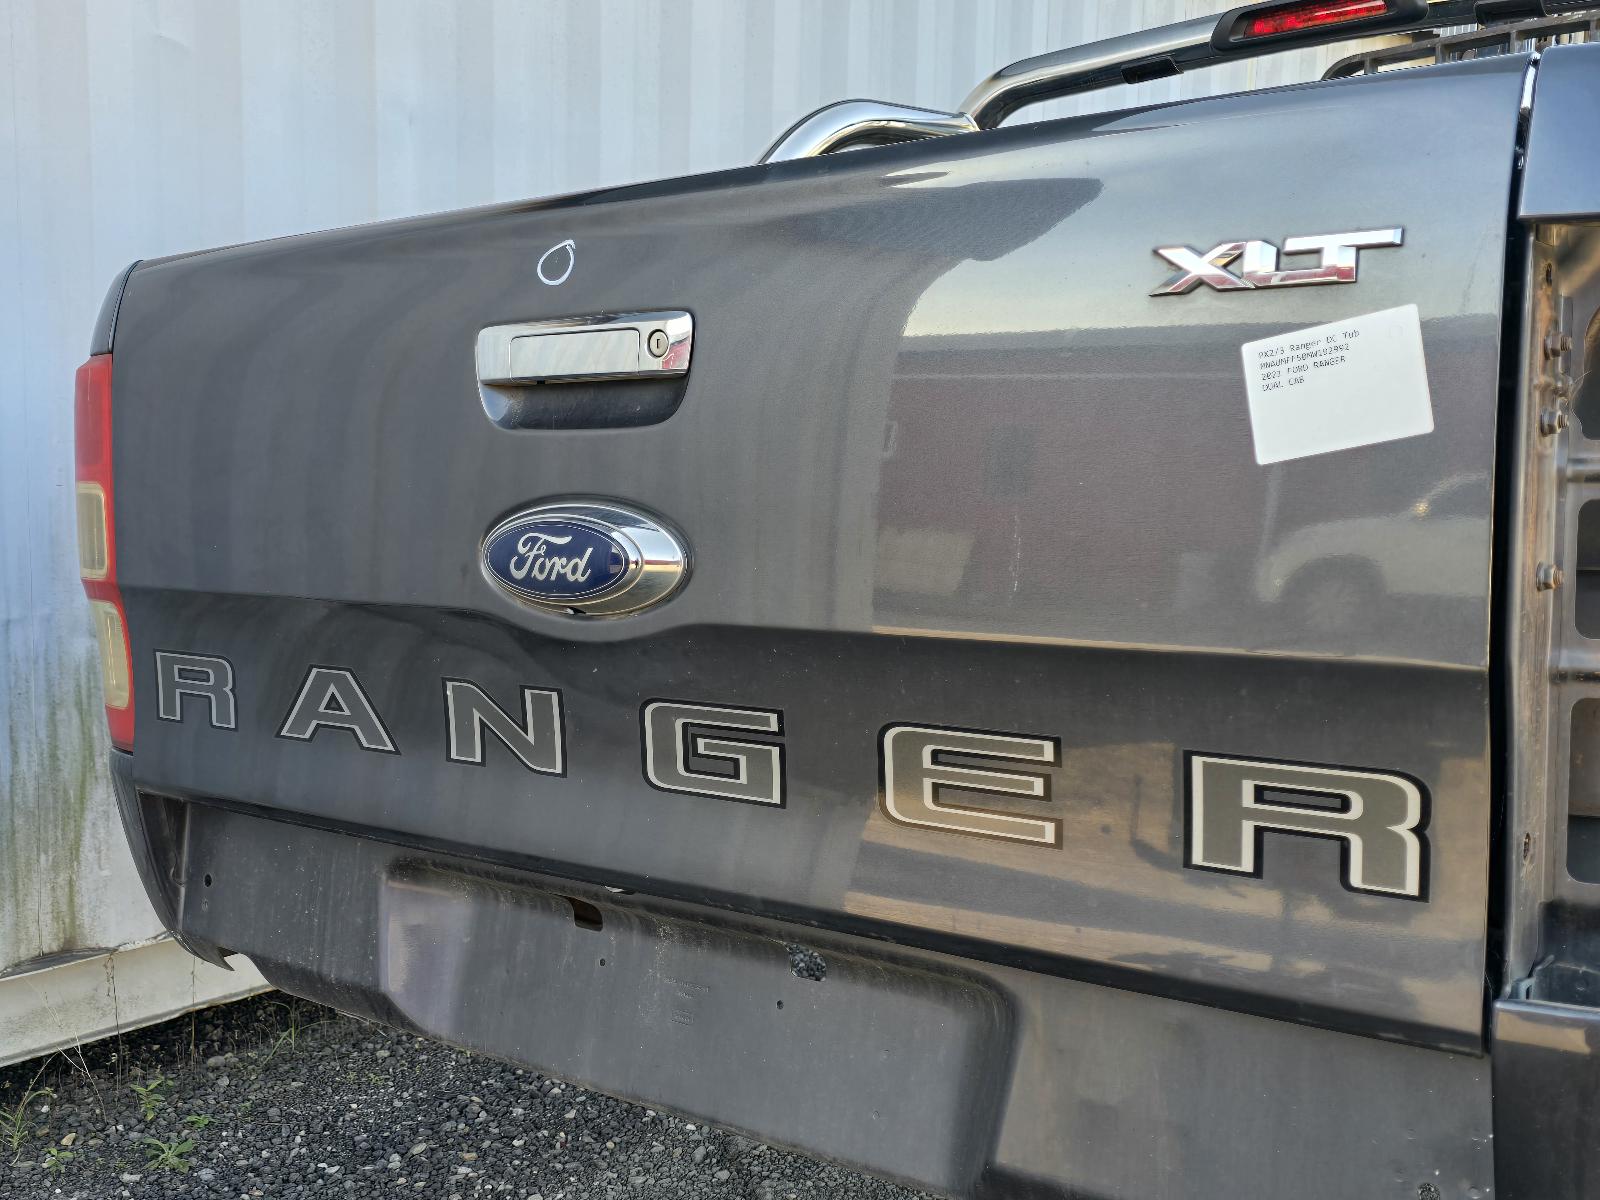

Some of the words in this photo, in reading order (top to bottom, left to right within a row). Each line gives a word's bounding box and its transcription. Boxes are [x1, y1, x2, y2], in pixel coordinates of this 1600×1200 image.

[1148, 227, 1404, 297] XLT
[1289, 339, 1322, 351] Ranger
[1342, 329, 1360, 339] Tub
[1287, 364, 1309, 374] FORD
[1313, 355, 1346, 369] RANGER
[1262, 381, 1284, 392] DUAL
[1288, 375, 1305, 386] CAB
[509, 532, 594, 583] Ford
[154, 649, 1432, 902] RANGER
